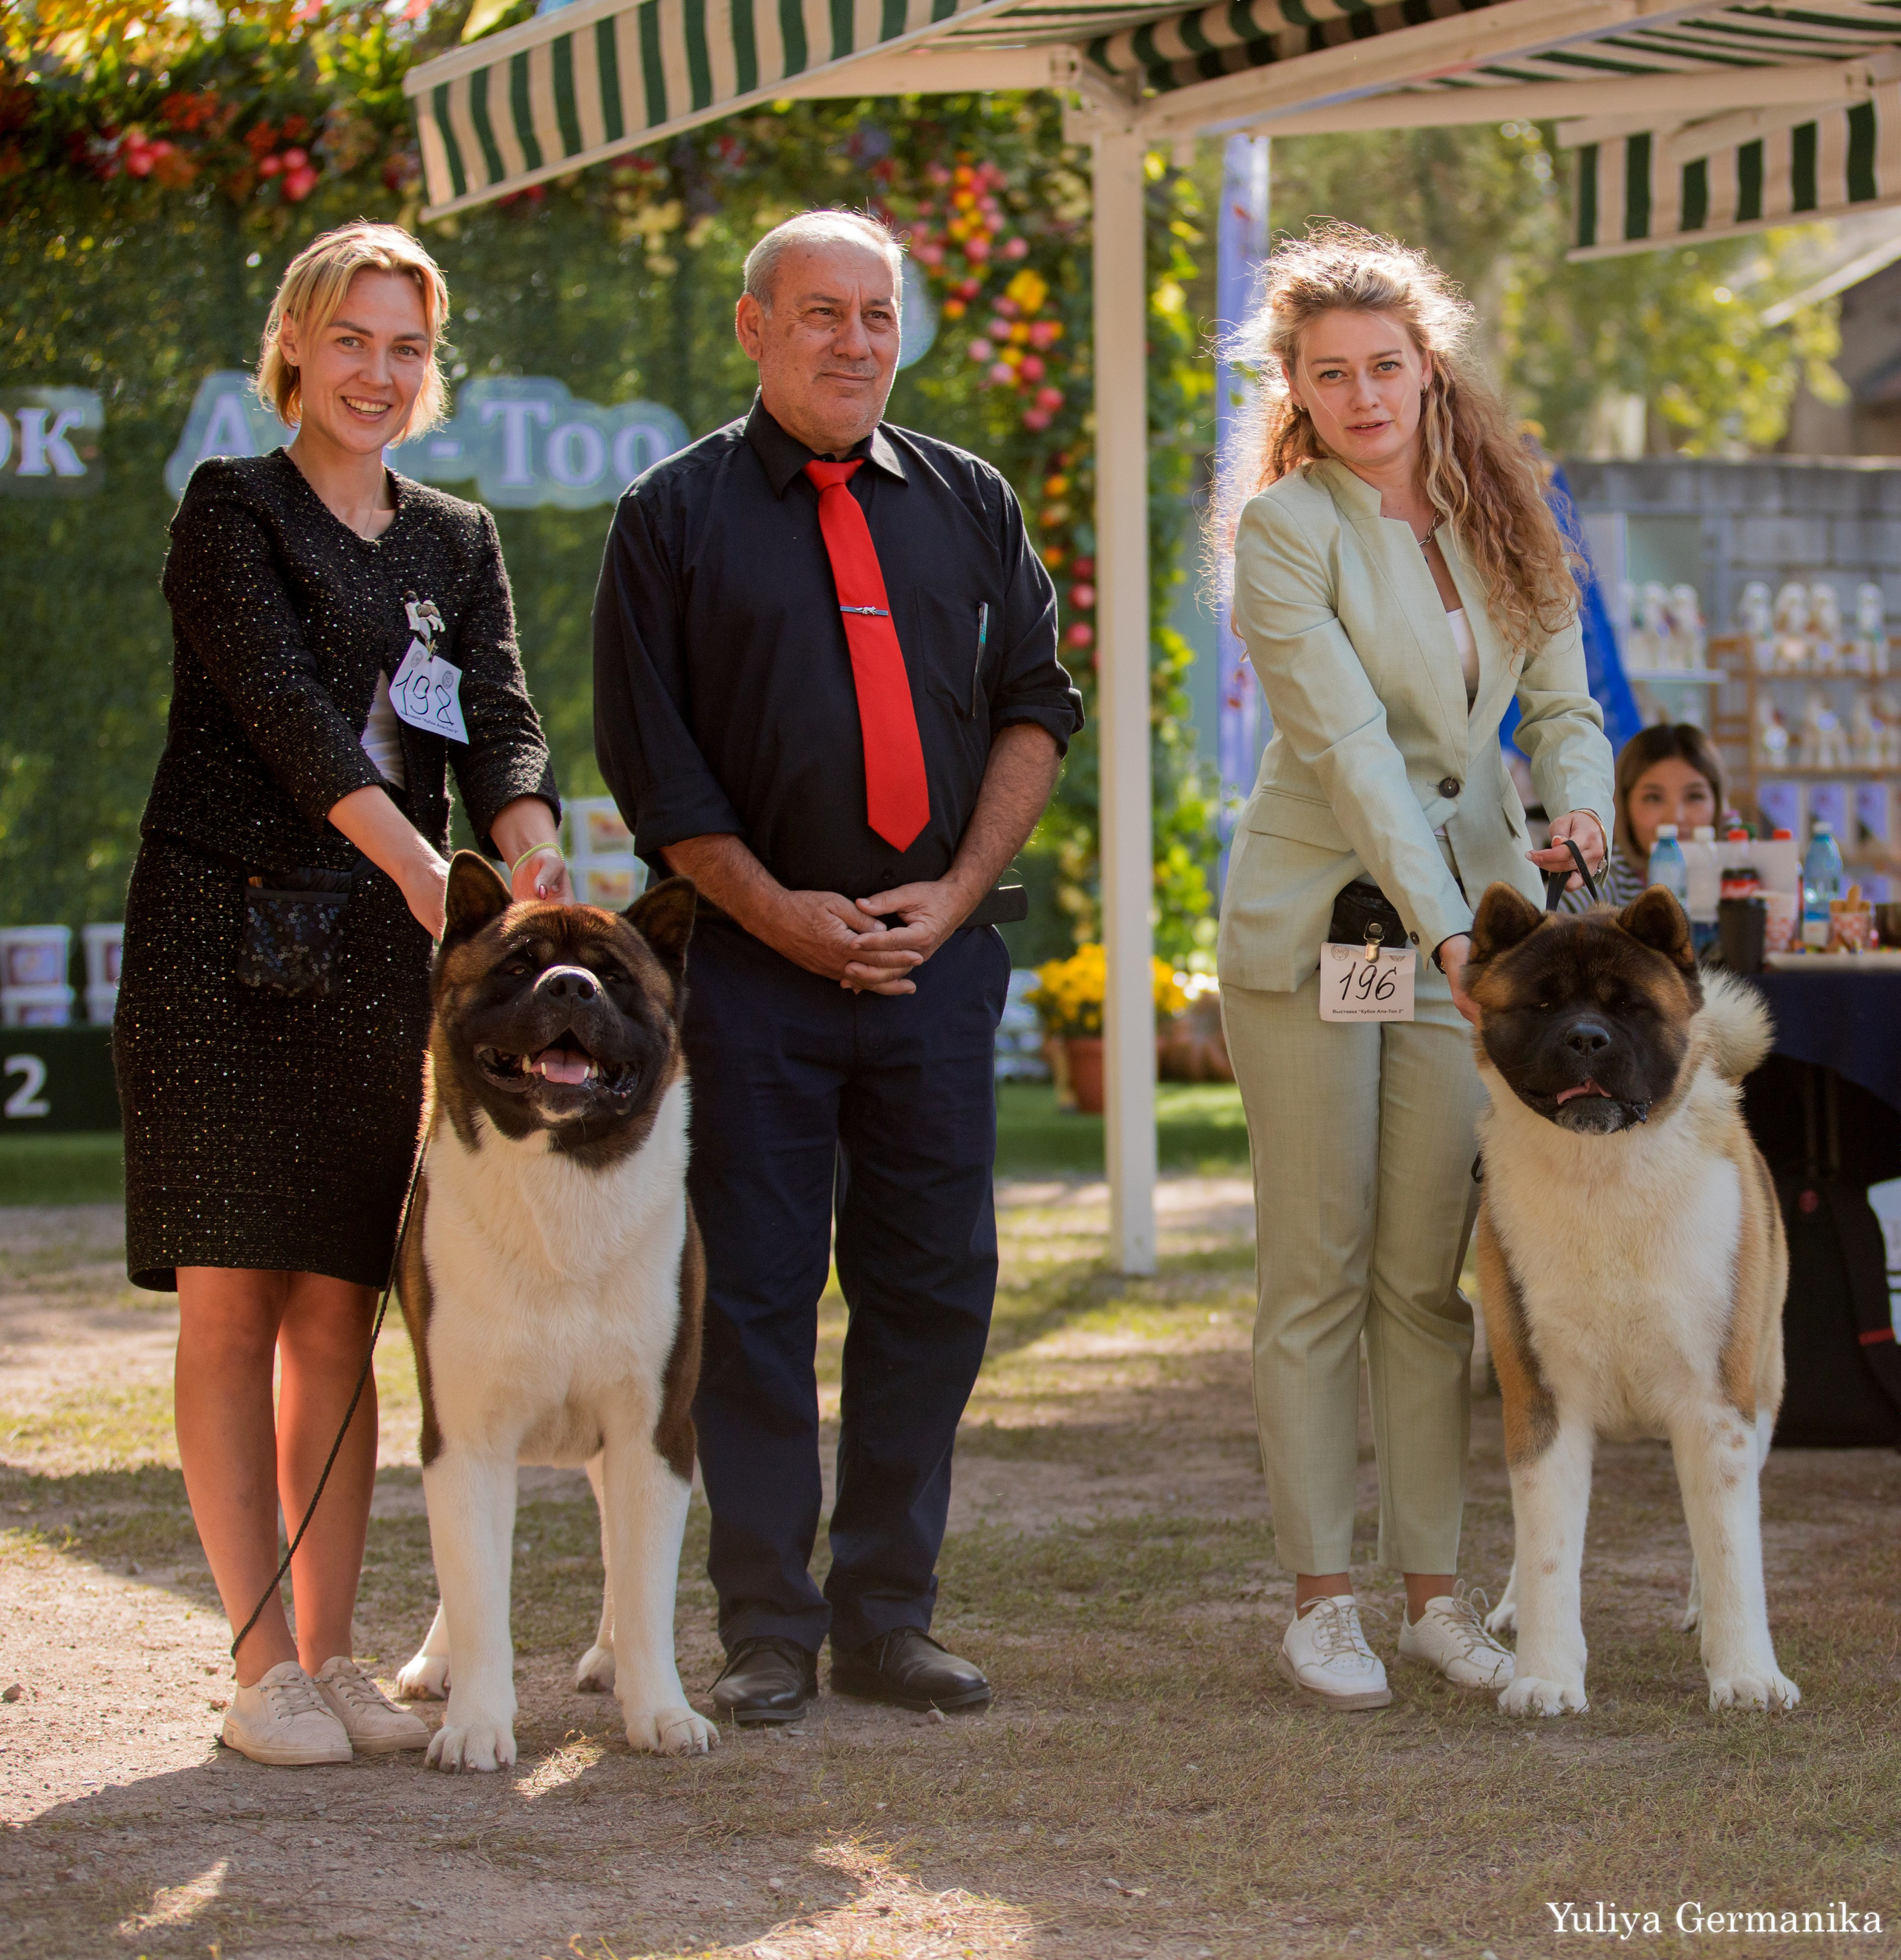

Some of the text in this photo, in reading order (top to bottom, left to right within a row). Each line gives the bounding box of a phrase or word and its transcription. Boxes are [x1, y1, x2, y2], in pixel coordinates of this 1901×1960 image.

[395, 670, 454, 727] 198
[1339, 961, 1398, 1001] 196
[4, 1054, 50, 1117] 2
